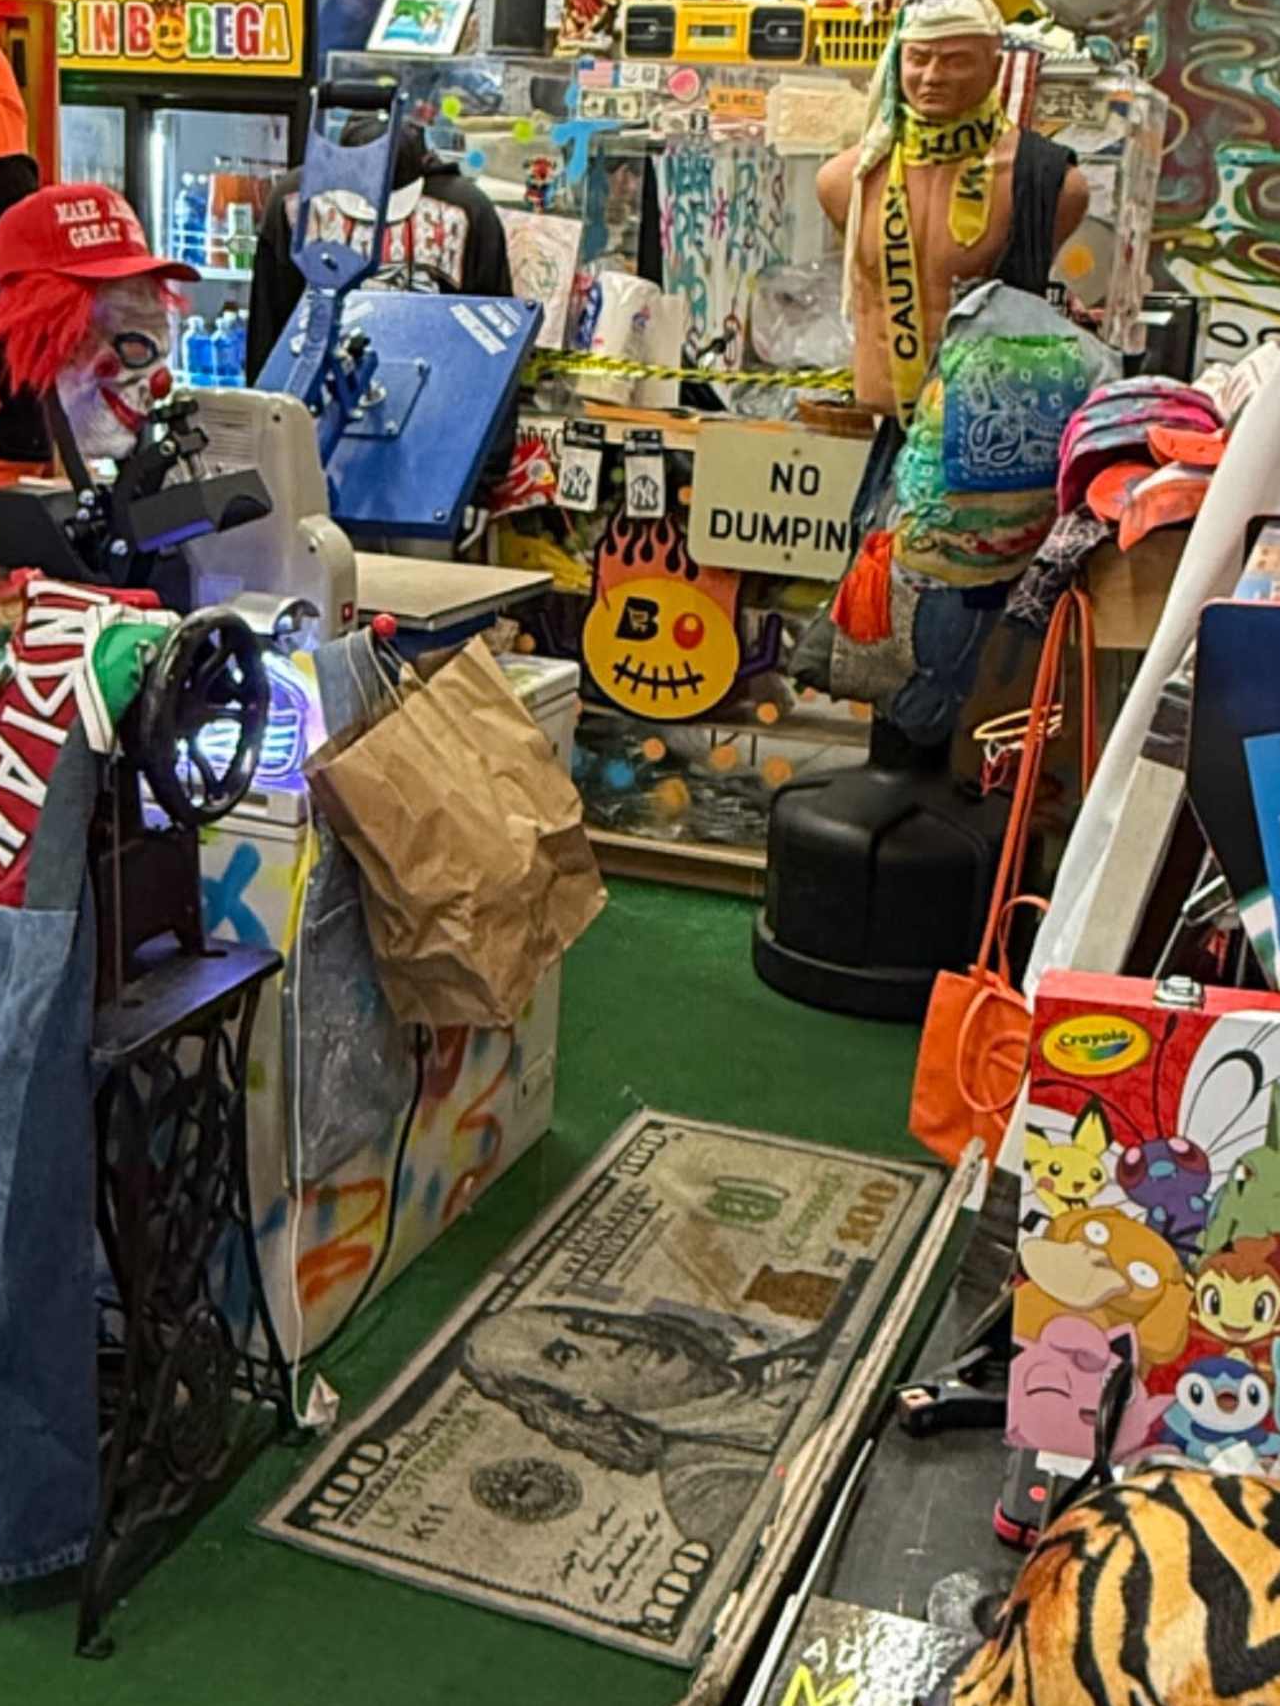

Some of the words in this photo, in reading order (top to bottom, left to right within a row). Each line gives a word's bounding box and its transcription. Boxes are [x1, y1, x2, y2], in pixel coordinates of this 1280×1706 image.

[76, 0, 122, 53] IN
[54, 198, 101, 225] MAKE
[68, 219, 123, 250] GREAT
[884, 185, 919, 360] CAUTION
[771, 462, 821, 496] NO
[708, 507, 849, 553] DUMPIN
[1059, 1028, 1129, 1047] Crayola
[308, 1442, 389, 1520] 100
[641, 1539, 714, 1627] 100
